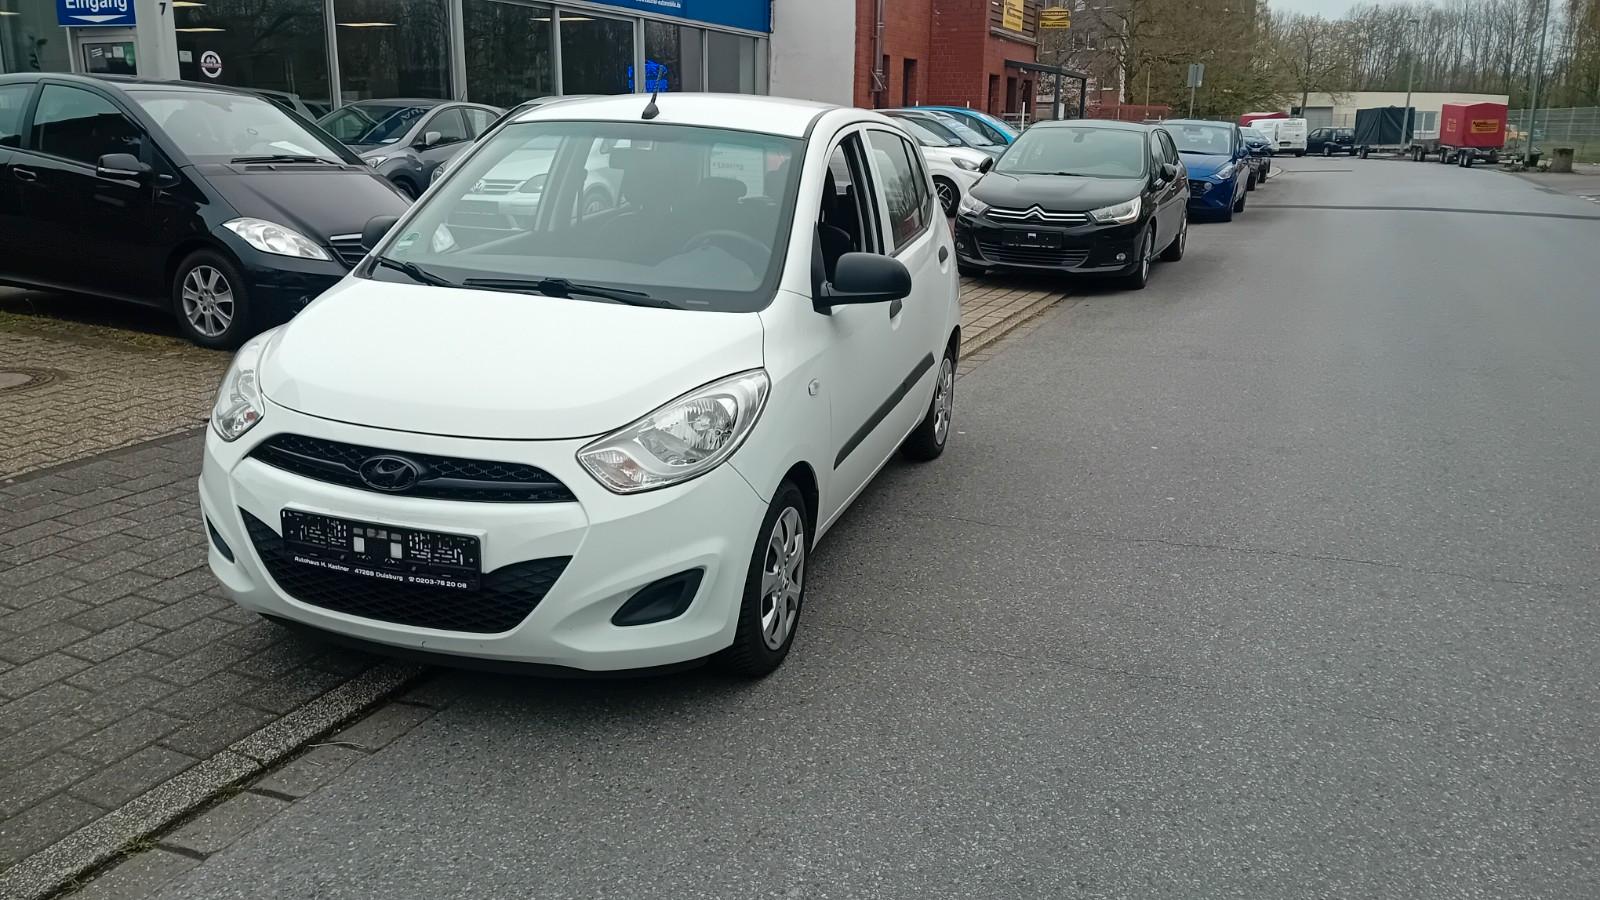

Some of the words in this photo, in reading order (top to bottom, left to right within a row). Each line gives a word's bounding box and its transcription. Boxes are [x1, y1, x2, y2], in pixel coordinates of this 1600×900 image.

[65, 0, 128, 12] Eingang
[159, 2, 166, 16] 7
[294, 556, 320, 566] Autohaus
[327, 562, 350, 572] Kastner
[375, 571, 403, 582] Duisburg
